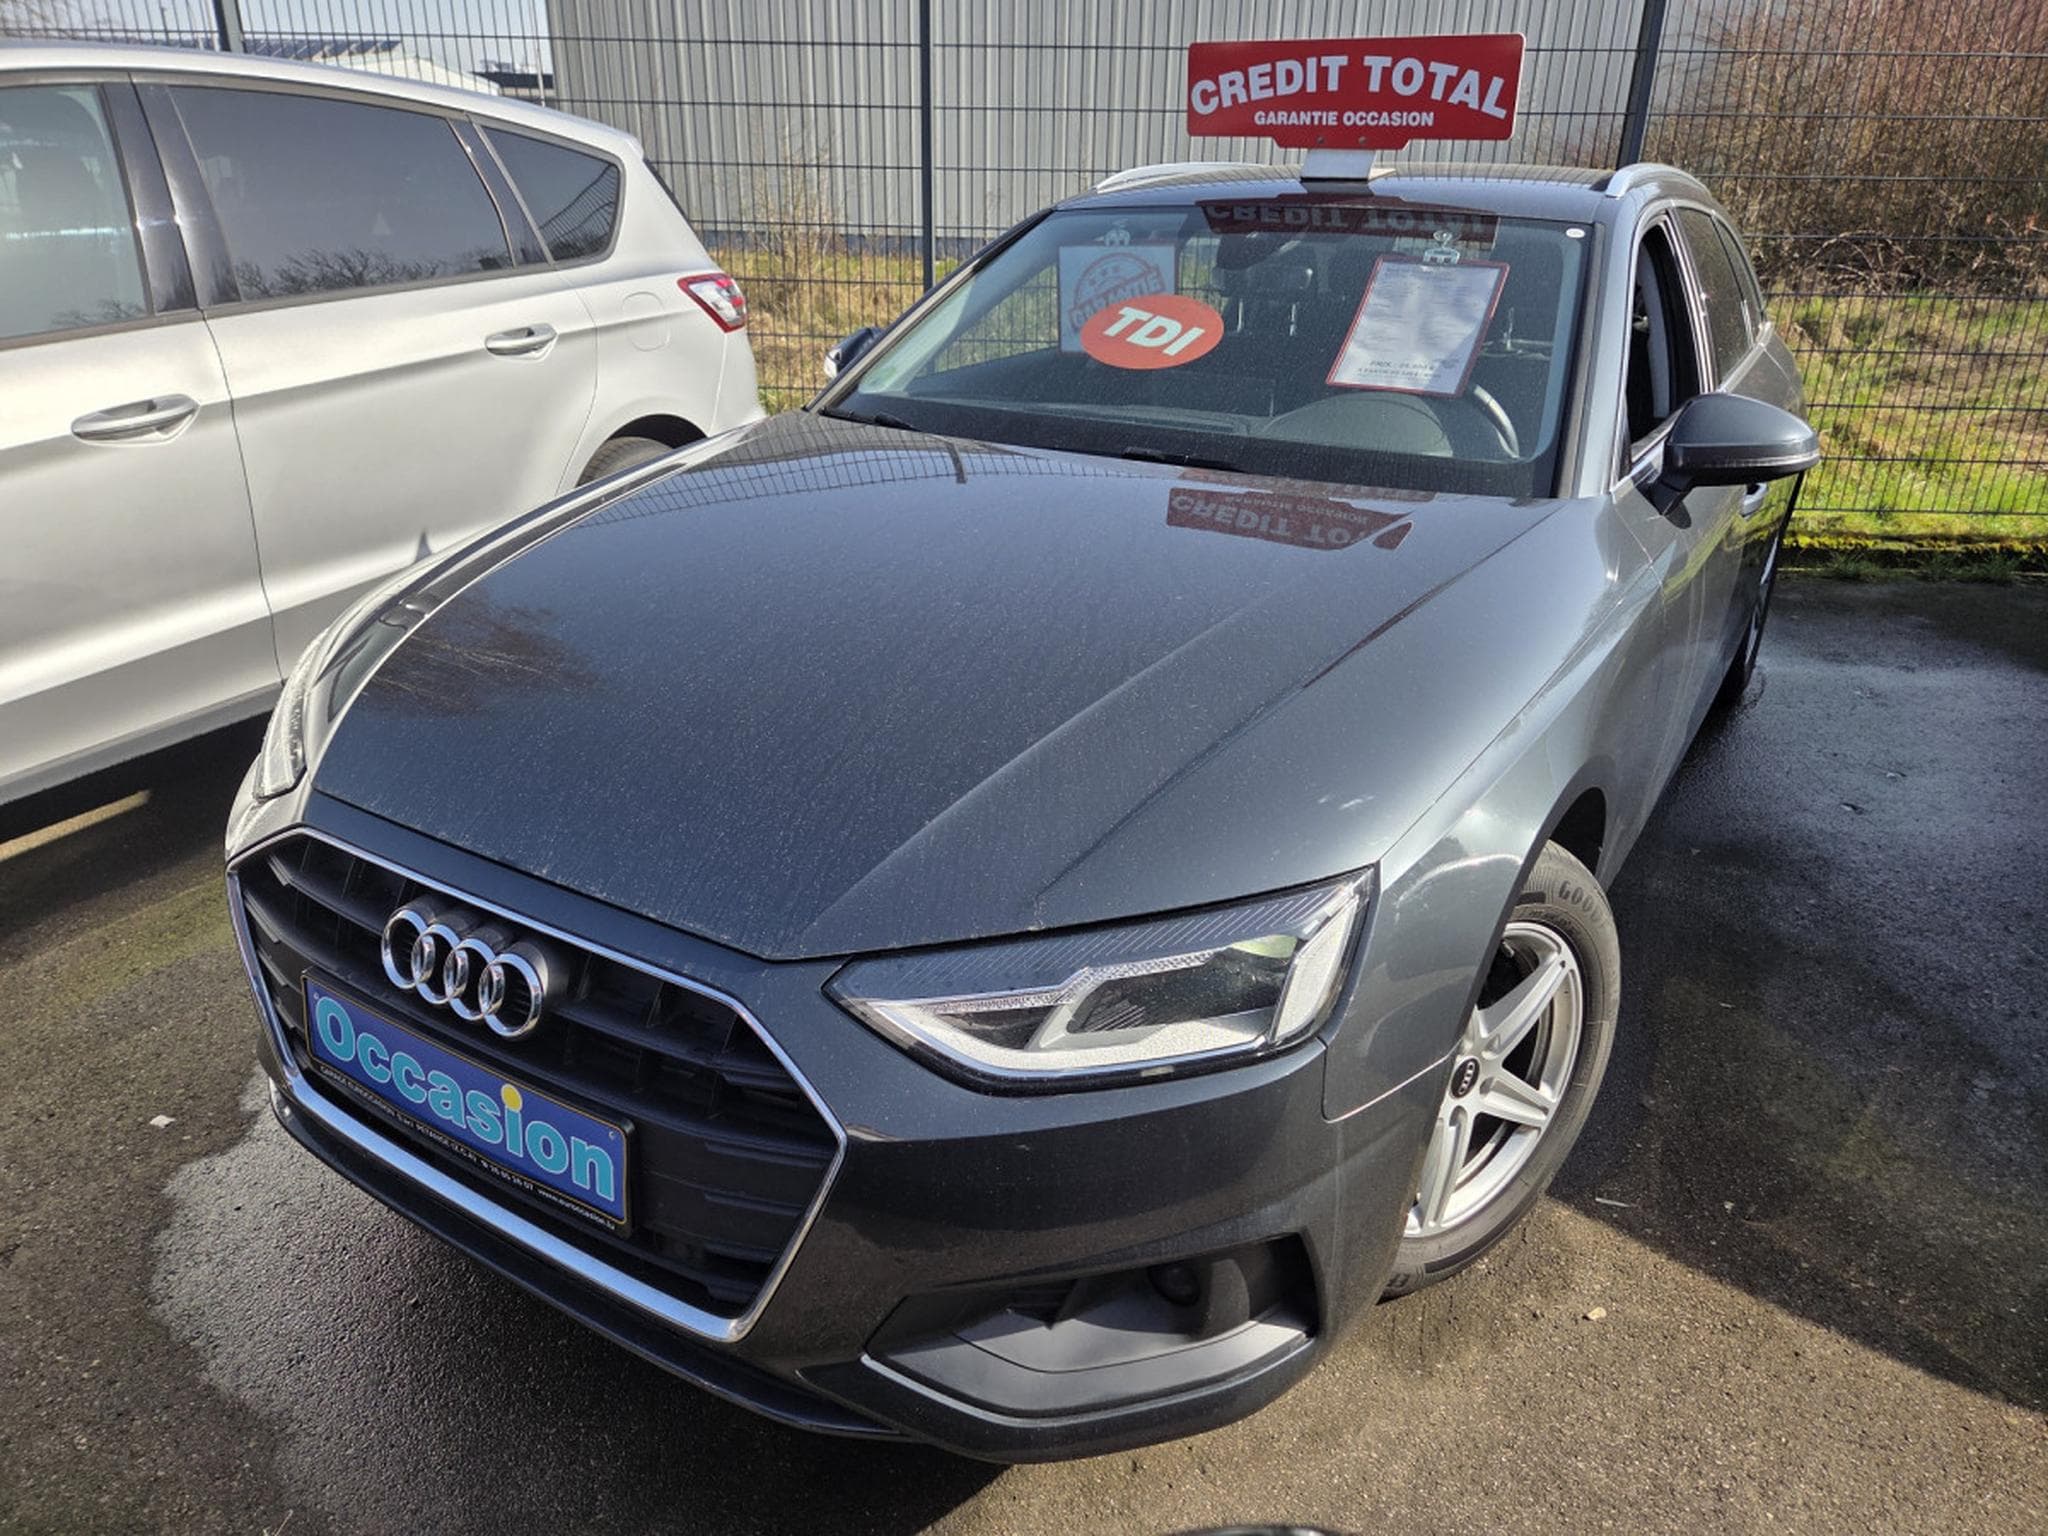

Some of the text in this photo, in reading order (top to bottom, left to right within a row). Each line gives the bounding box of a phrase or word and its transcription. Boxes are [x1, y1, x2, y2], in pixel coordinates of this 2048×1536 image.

[1191, 55, 1507, 120] CREDIT TOTAL
[1254, 111, 1434, 127] GARANTIE OCCASION
[1103, 306, 1206, 356] TDI
[316, 996, 615, 1201] Occasion
